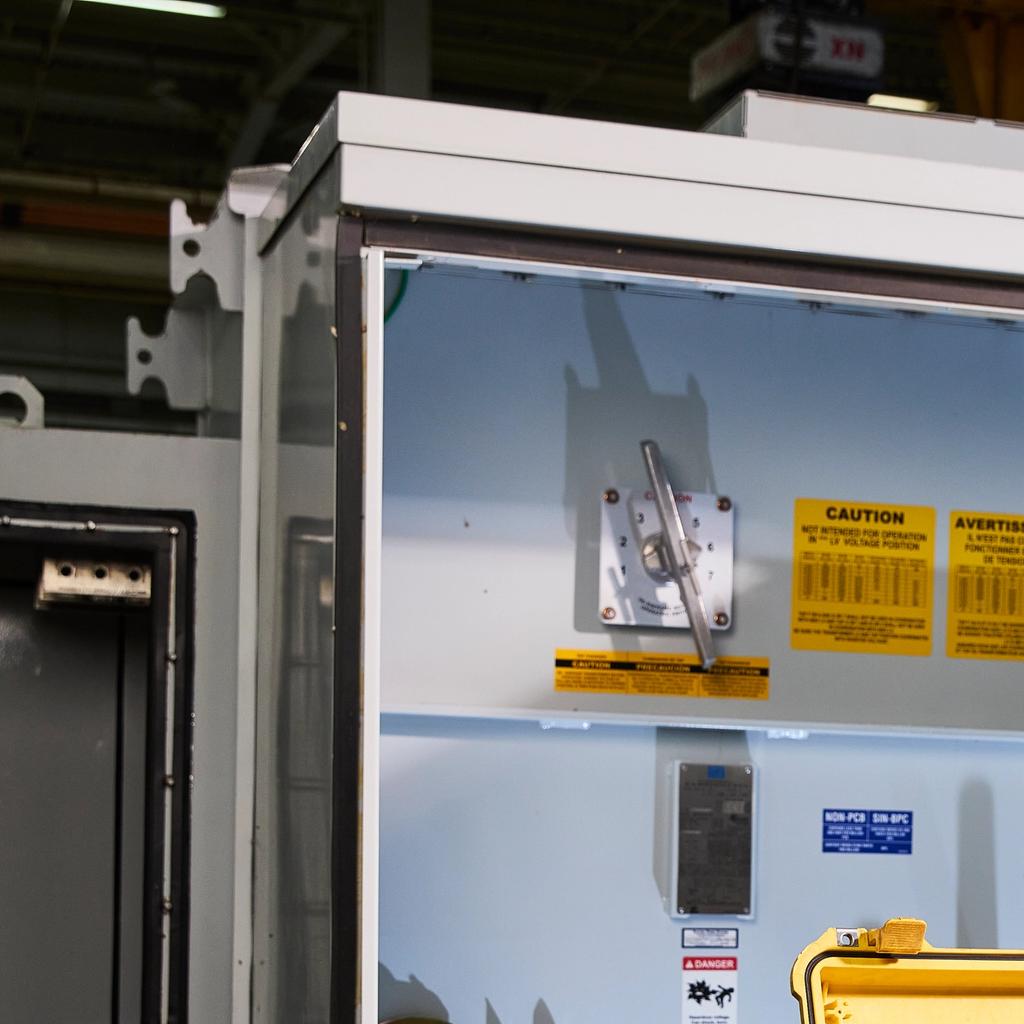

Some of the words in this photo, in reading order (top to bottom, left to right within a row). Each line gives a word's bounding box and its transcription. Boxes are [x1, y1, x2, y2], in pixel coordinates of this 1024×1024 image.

[826, 506, 904, 524] CAUTION
[572, 661, 611, 669] CAUTION
[825, 811, 866, 823] NON-PCB
[695, 959, 734, 969] DANGER
